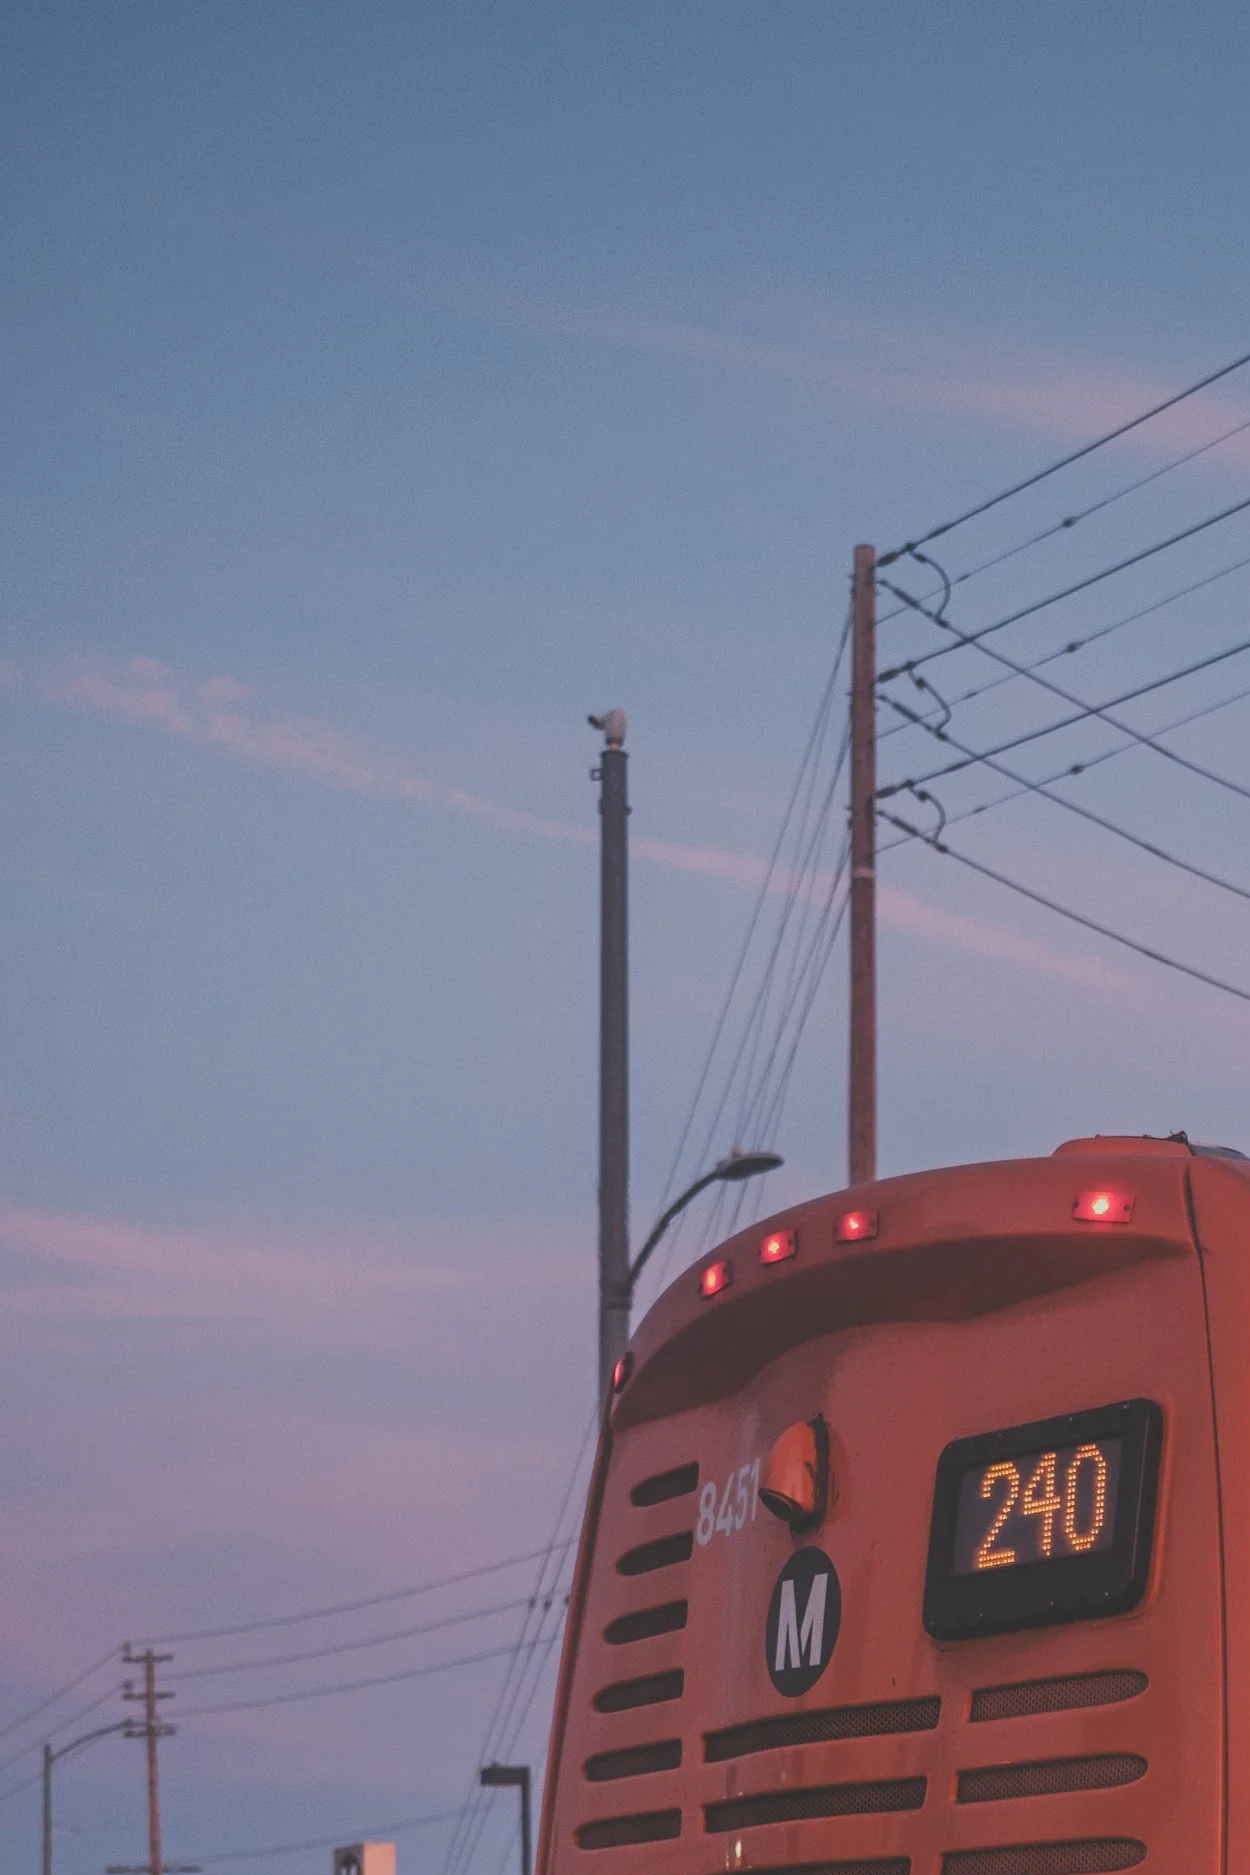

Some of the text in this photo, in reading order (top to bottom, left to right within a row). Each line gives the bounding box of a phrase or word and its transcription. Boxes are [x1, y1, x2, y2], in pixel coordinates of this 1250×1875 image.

[697, 1456, 762, 1546] 8451
[977, 1443, 1107, 1569] 240
[775, 1573, 829, 1671] M
